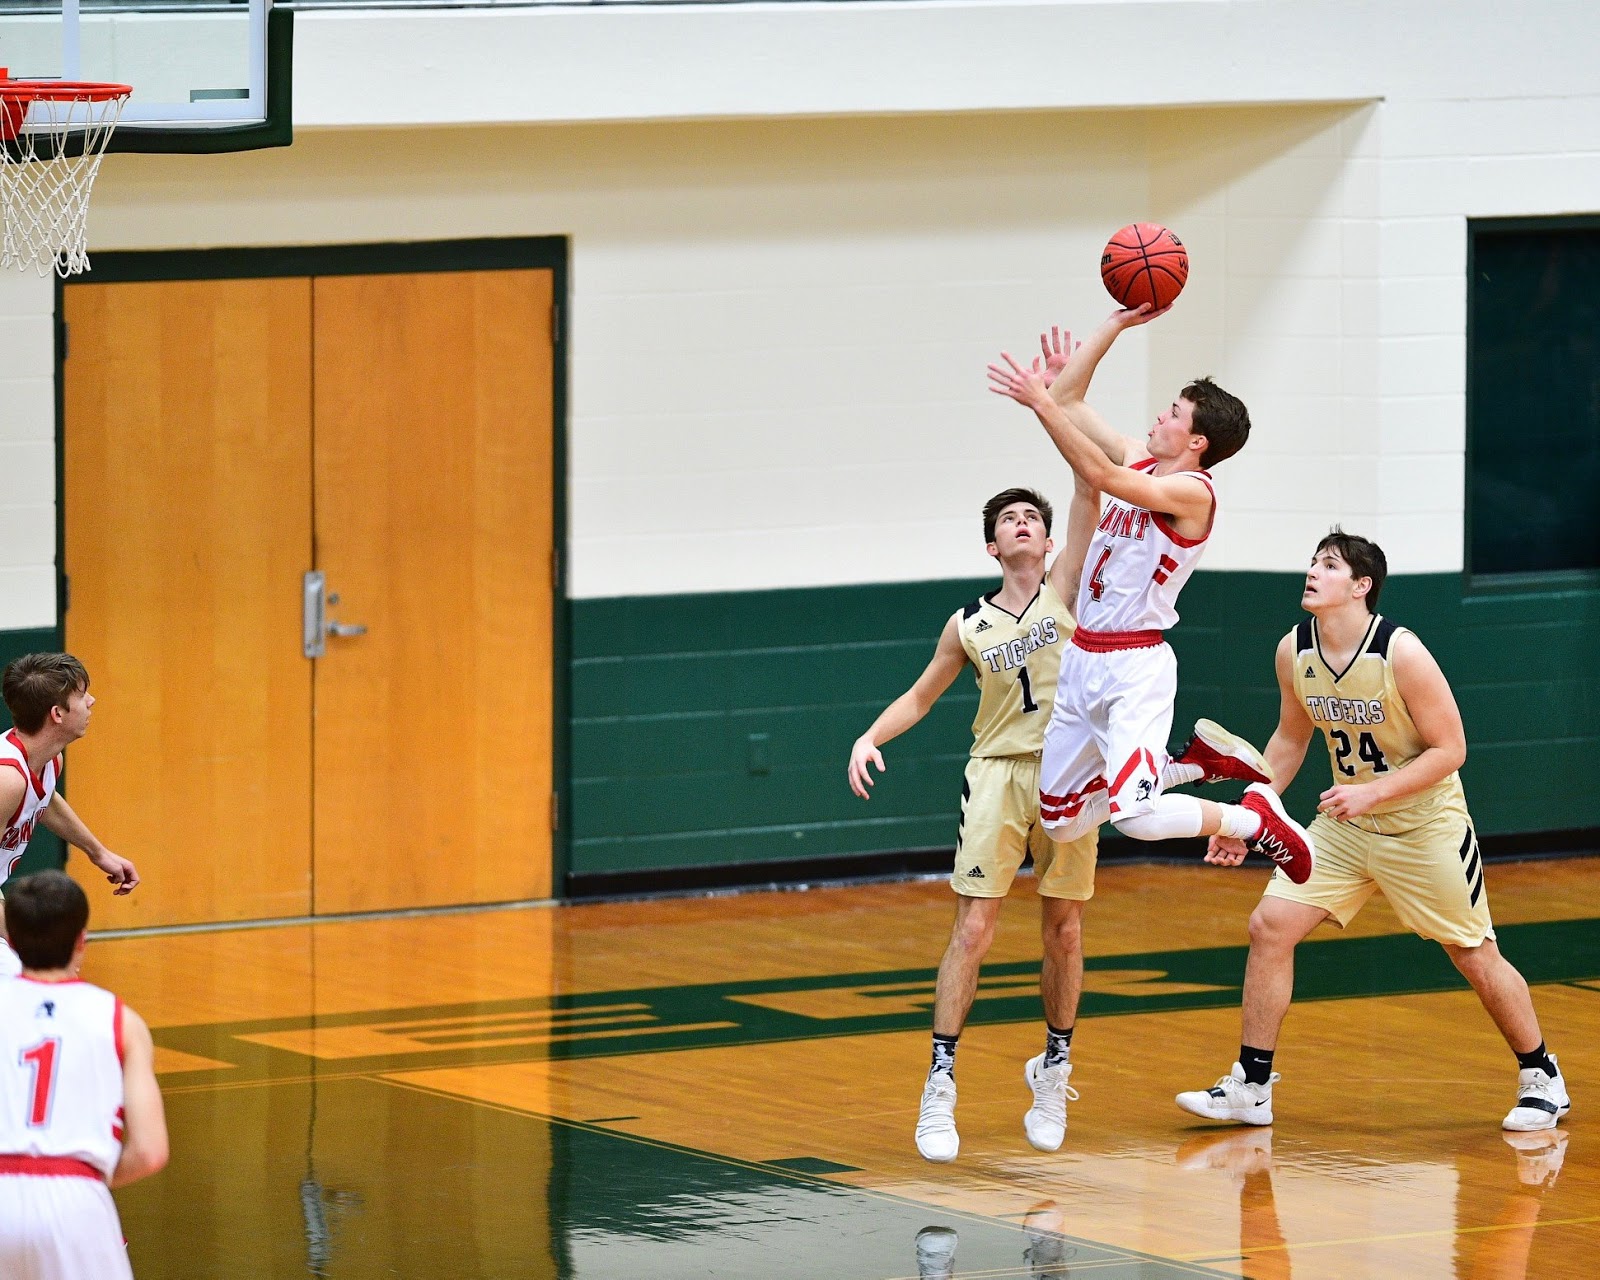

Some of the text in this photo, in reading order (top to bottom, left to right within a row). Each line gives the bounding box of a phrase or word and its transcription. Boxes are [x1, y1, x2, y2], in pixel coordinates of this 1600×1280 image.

[1088, 545, 1113, 603] 4
[981, 616, 1059, 673] TIGERS
[1016, 666, 1039, 714] 1
[1306, 696, 1385, 724] TIGERS
[1330, 729, 1389, 776] 24
[18, 1036, 62, 1128] 1
